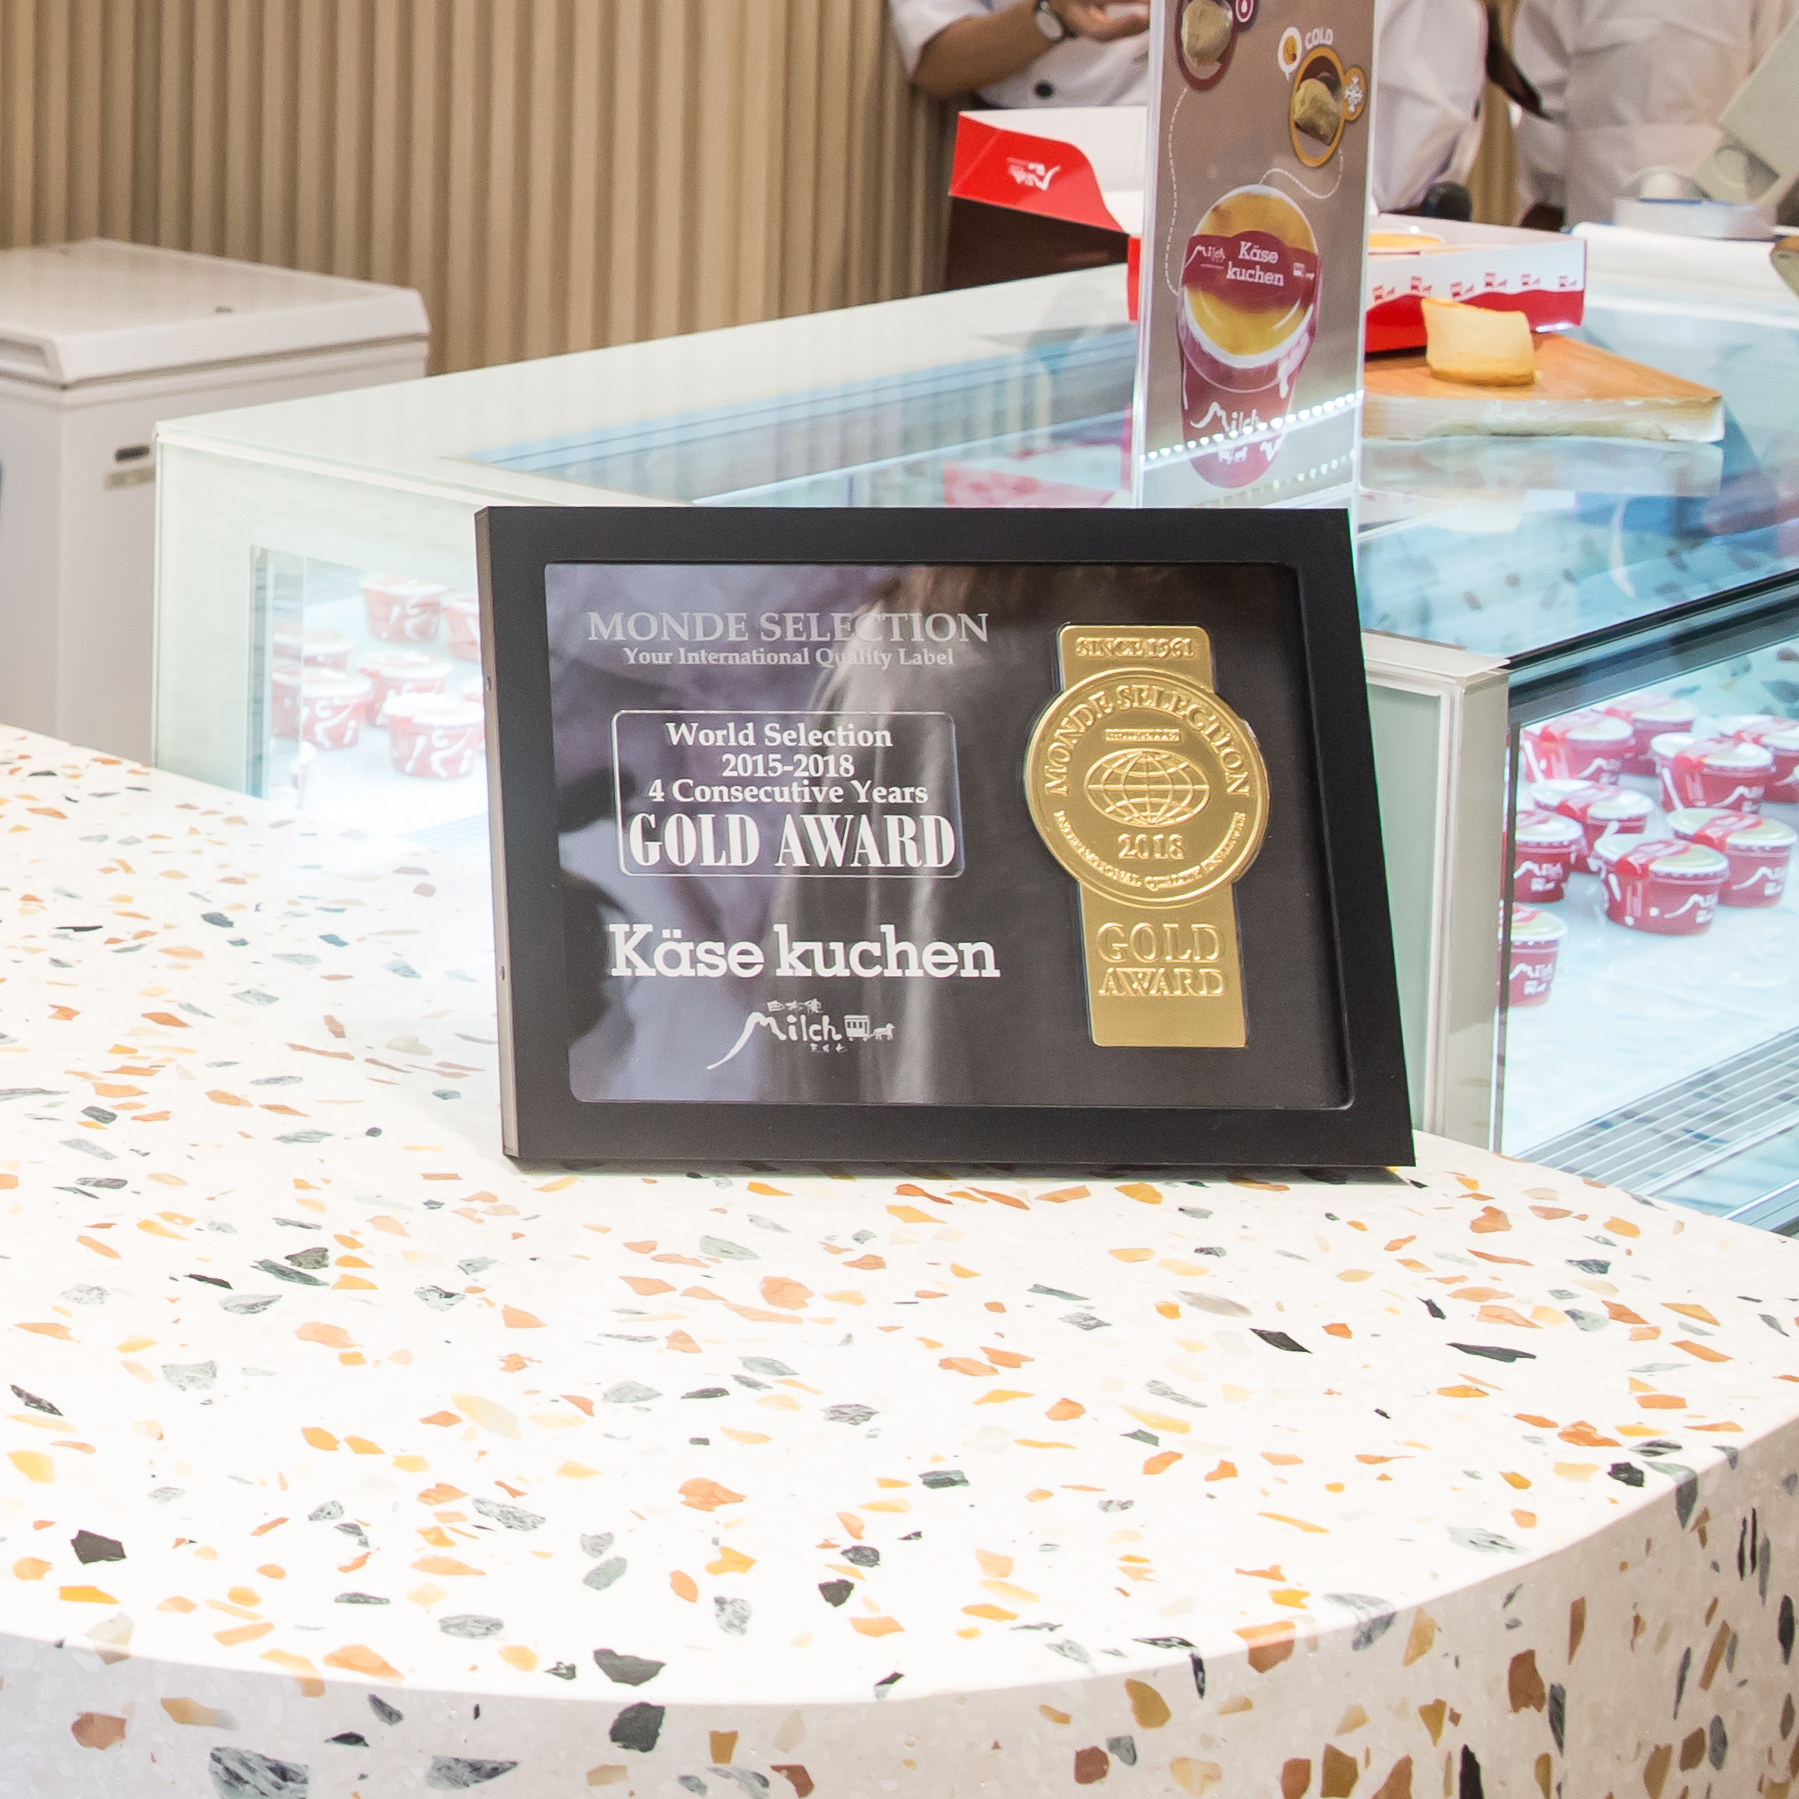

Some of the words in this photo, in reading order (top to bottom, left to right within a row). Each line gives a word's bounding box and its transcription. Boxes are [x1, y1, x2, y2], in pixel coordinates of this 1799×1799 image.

[1305, 27, 1334, 49] COLD
[1238, 240, 1279, 264] Käse
[1225, 260, 1284, 287] kuchen
[587, 611, 750, 642] MONDE
[760, 611, 990, 643] SELECTION
[623, 647, 673, 666] Your
[678, 647, 811, 666] International
[815, 647, 893, 671] Quality
[900, 647, 955, 667] Label
[1075, 636, 1144, 658] SINCE
[1146, 636, 1194, 659] 1961
[665, 722, 756, 747] World
[764, 722, 894, 748] Selection
[1044, 690, 1114, 797] MONDE
[1116, 684, 1251, 798] SELECTION
[721, 753, 856, 778] 2015-2018
[648, 779, 665, 802] 4
[671, 779, 844, 804] Consecutive
[849, 779, 929, 804] Years
[629, 812, 761, 867] GOLD
[773, 813, 957, 868] AWARD
[1117, 833, 1186, 861] 2018
[608, 923, 765, 978] Käse
[772, 923, 1001, 978] kuchen
[1096, 922, 1221, 963] GOLD
[1098, 967, 1224, 997] AWARD
[706, 1011, 842, 1070] Milch
